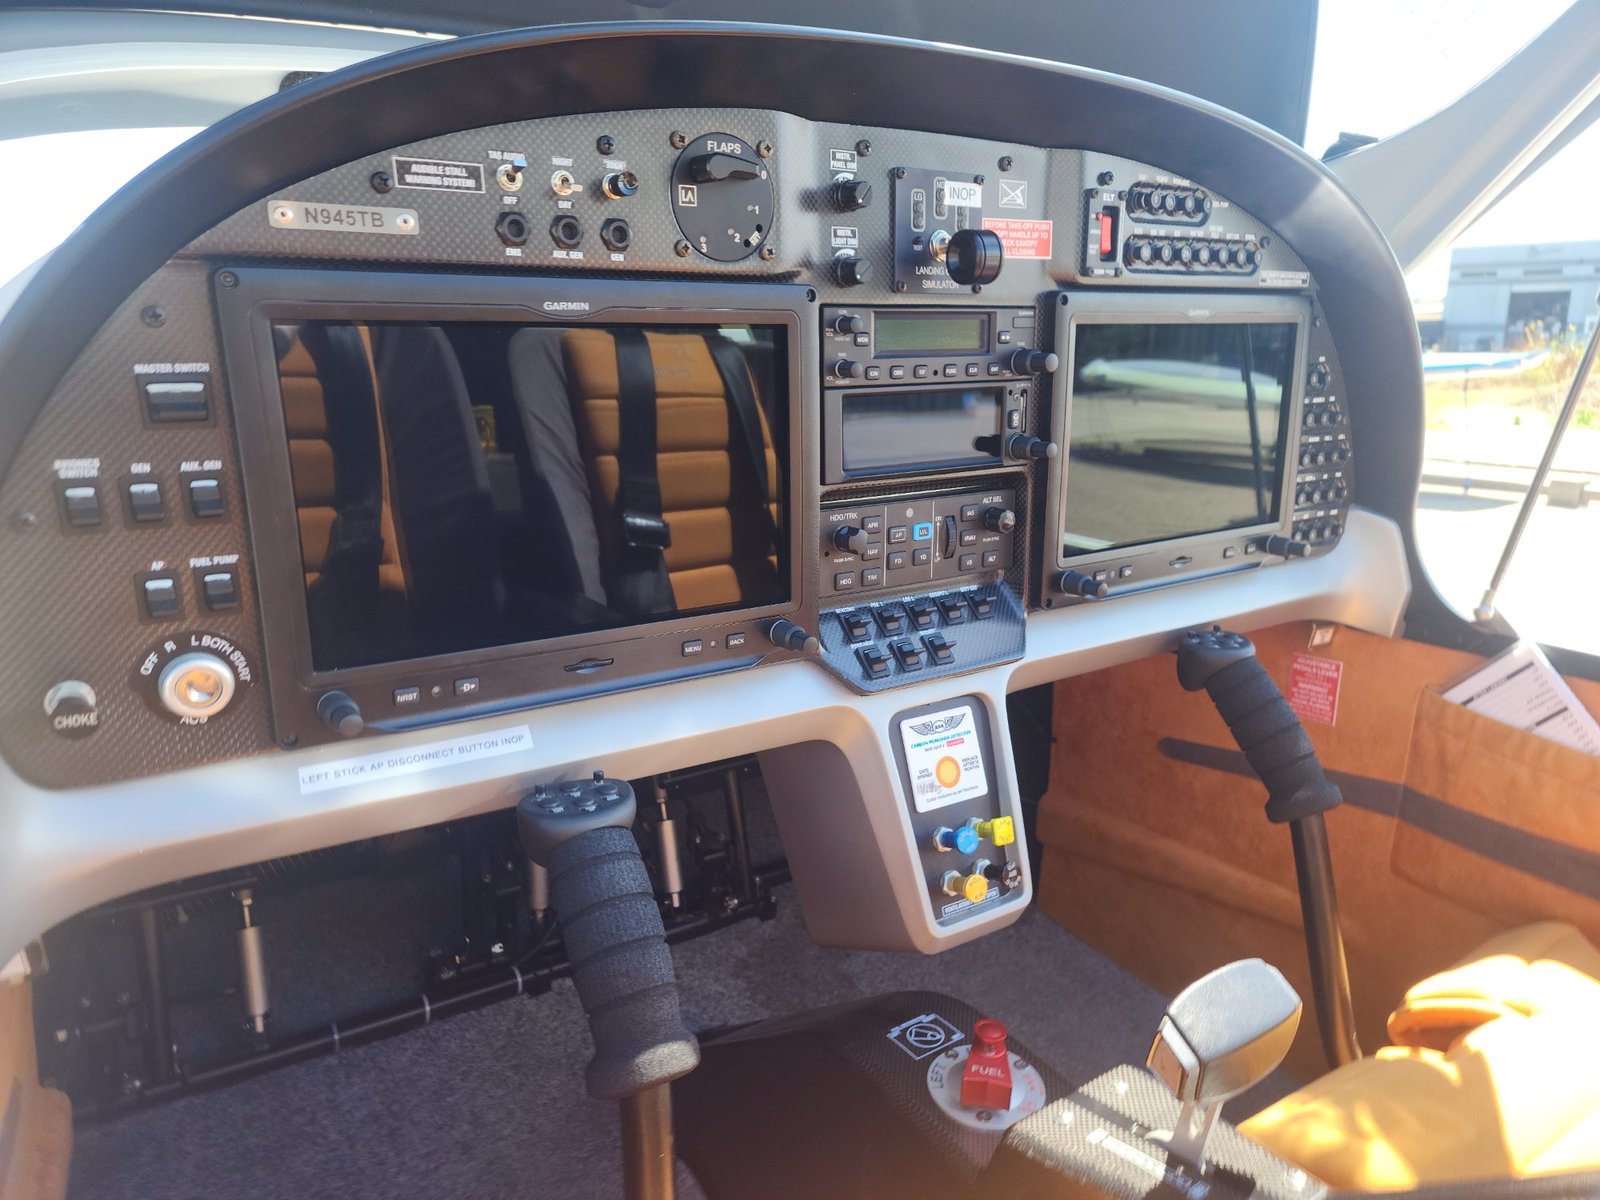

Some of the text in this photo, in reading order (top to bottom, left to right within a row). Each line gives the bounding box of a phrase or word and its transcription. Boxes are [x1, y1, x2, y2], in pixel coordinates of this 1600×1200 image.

[707, 140, 741, 154] FLAPS
[444, 166, 469, 177] STALL
[760, 170, 767, 180] 0
[949, 187, 976, 201] INOP
[558, 200, 572, 209] DAY
[754, 205, 760, 215] 1
[304, 207, 385, 228] N945TB
[734, 233, 741, 243] 2
[1040, 231, 1048, 239] TO
[700, 243, 707, 253] 3
[915, 265, 945, 276] LANDING
[543, 301, 590, 311] GARMIN
[133, 362, 211, 375] MASTER SWITCH
[982, 495, 1003, 504] ALT SEL
[829, 511, 858, 522] HDG/TRK
[867, 521, 879, 529] APR
[190, 553, 239, 569] FUEL PUMP
[190, 634, 200, 646] L
[201, 634, 235, 656] BOTH
[729, 637, 745, 646] BACK
[163, 640, 177, 653] R
[684, 645, 702, 653] MENU
[140, 651, 159, 676] OFF
[229, 650, 251, 682] START
[396, 691, 418, 703] NRST
[53, 711, 98, 730] CHOKE
[301, 734, 525, 785] LEFT STICK AP DISCONNECT BUTTON INOP
[970, 1063, 1005, 1078] FUEL
